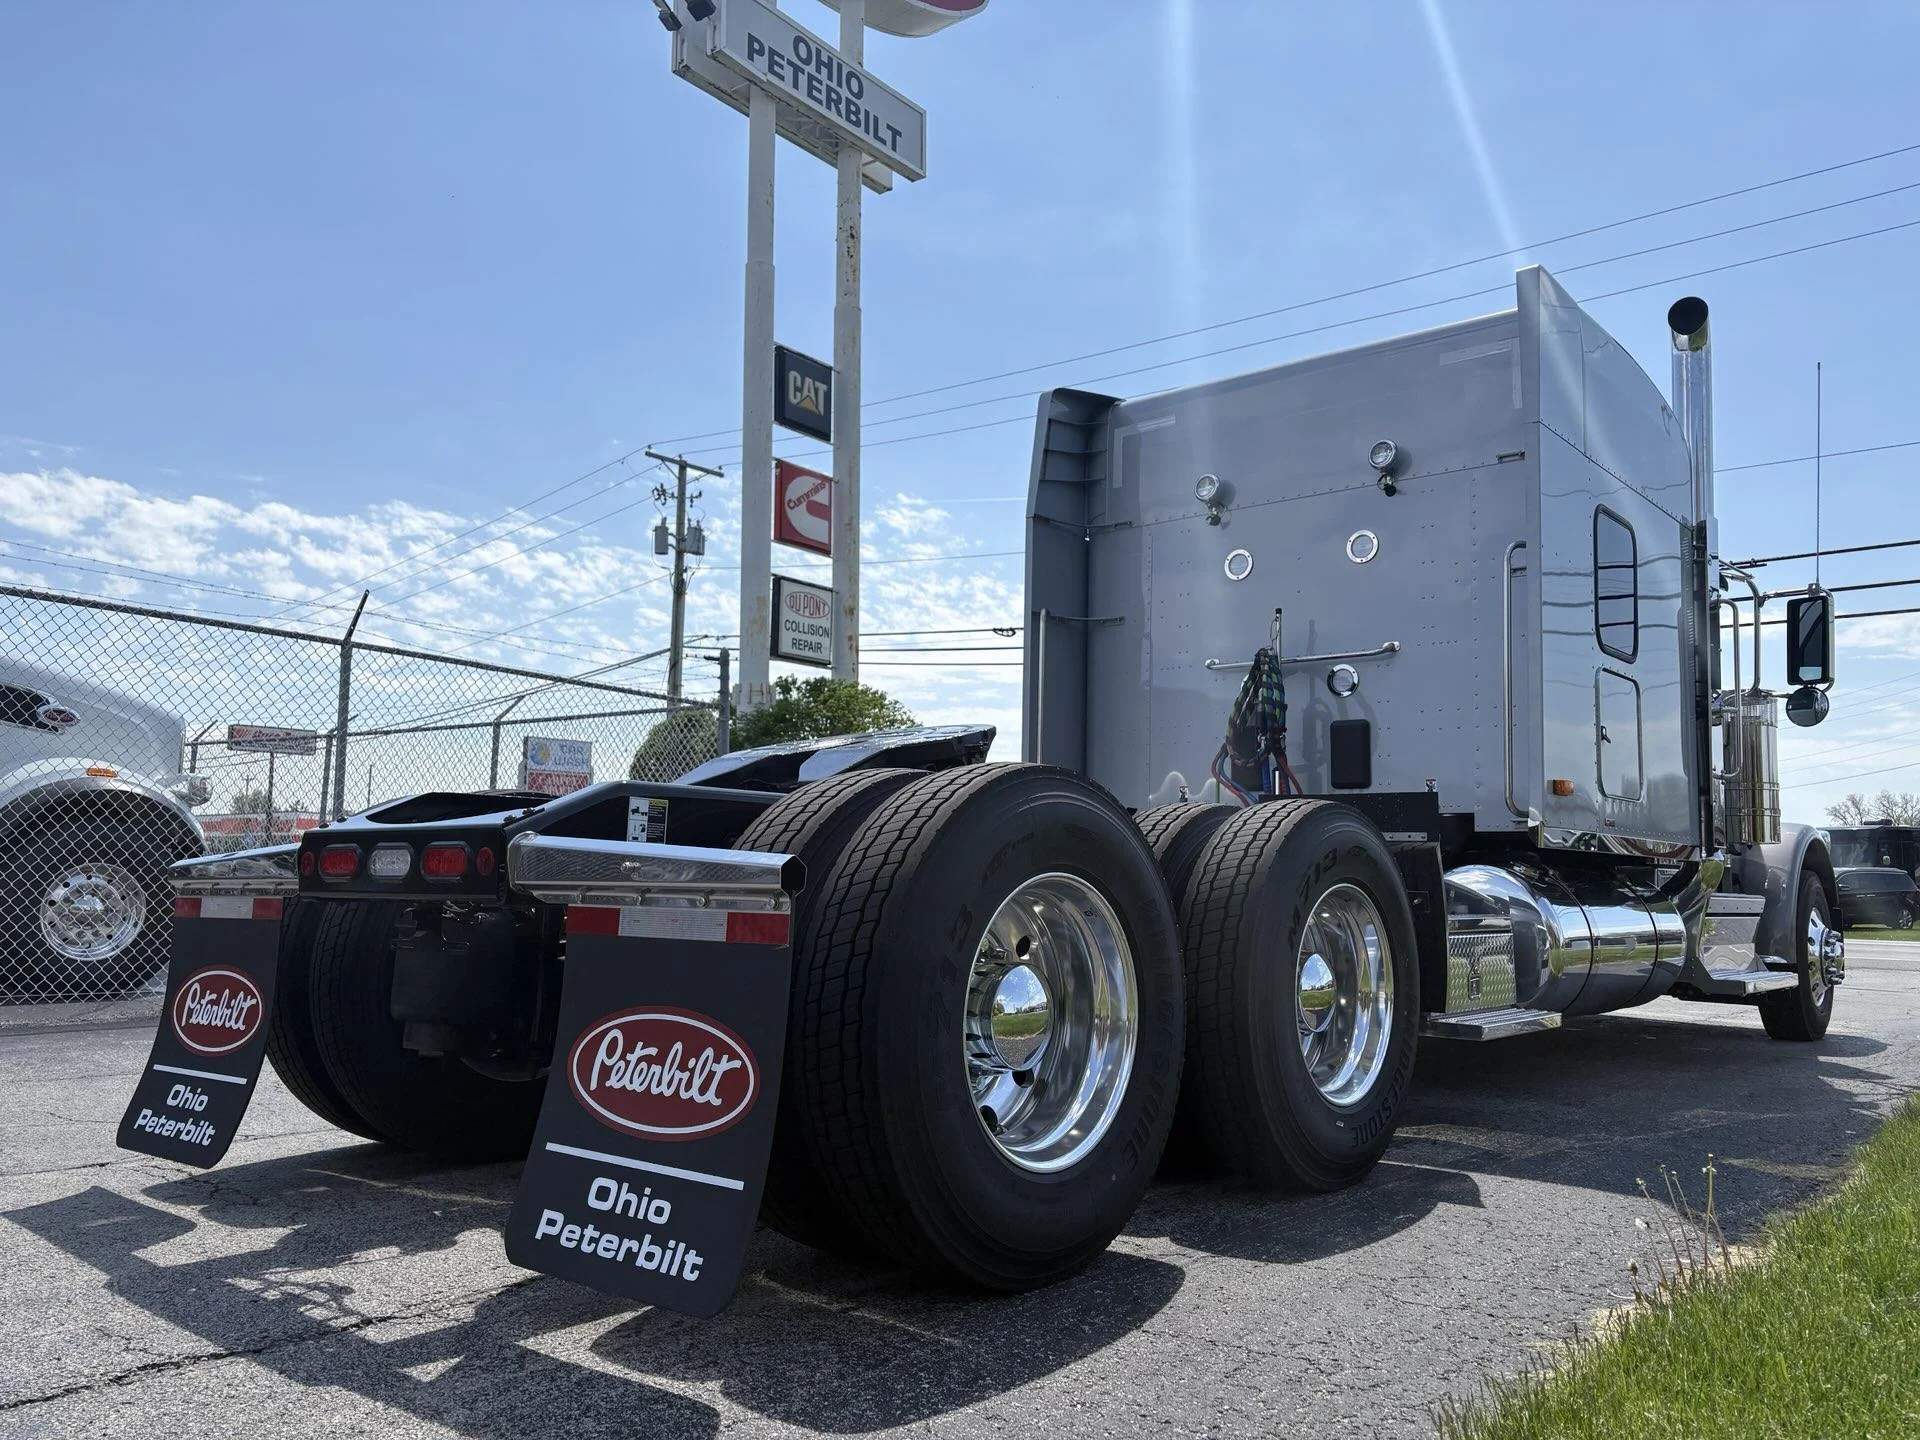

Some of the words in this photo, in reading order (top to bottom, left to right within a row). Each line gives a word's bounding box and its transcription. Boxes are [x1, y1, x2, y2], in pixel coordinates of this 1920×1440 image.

[792, 35, 864, 100] OHIO
[747, 32, 903, 152] PETERBILT
[788, 370, 828, 416] CAT
[787, 480, 827, 510] Cummins
[784, 619, 830, 639] COLLISION
[791, 638, 823, 654] REPAIR
[181, 982, 257, 1031] Peterbilt
[589, 1028, 742, 1107] Peterbilt
[166, 1083, 209, 1112] Ohio
[134, 1108, 216, 1147] Peterbilt
[587, 1176, 672, 1225] Ohio
[534, 1208, 704, 1282] Peterbilt
